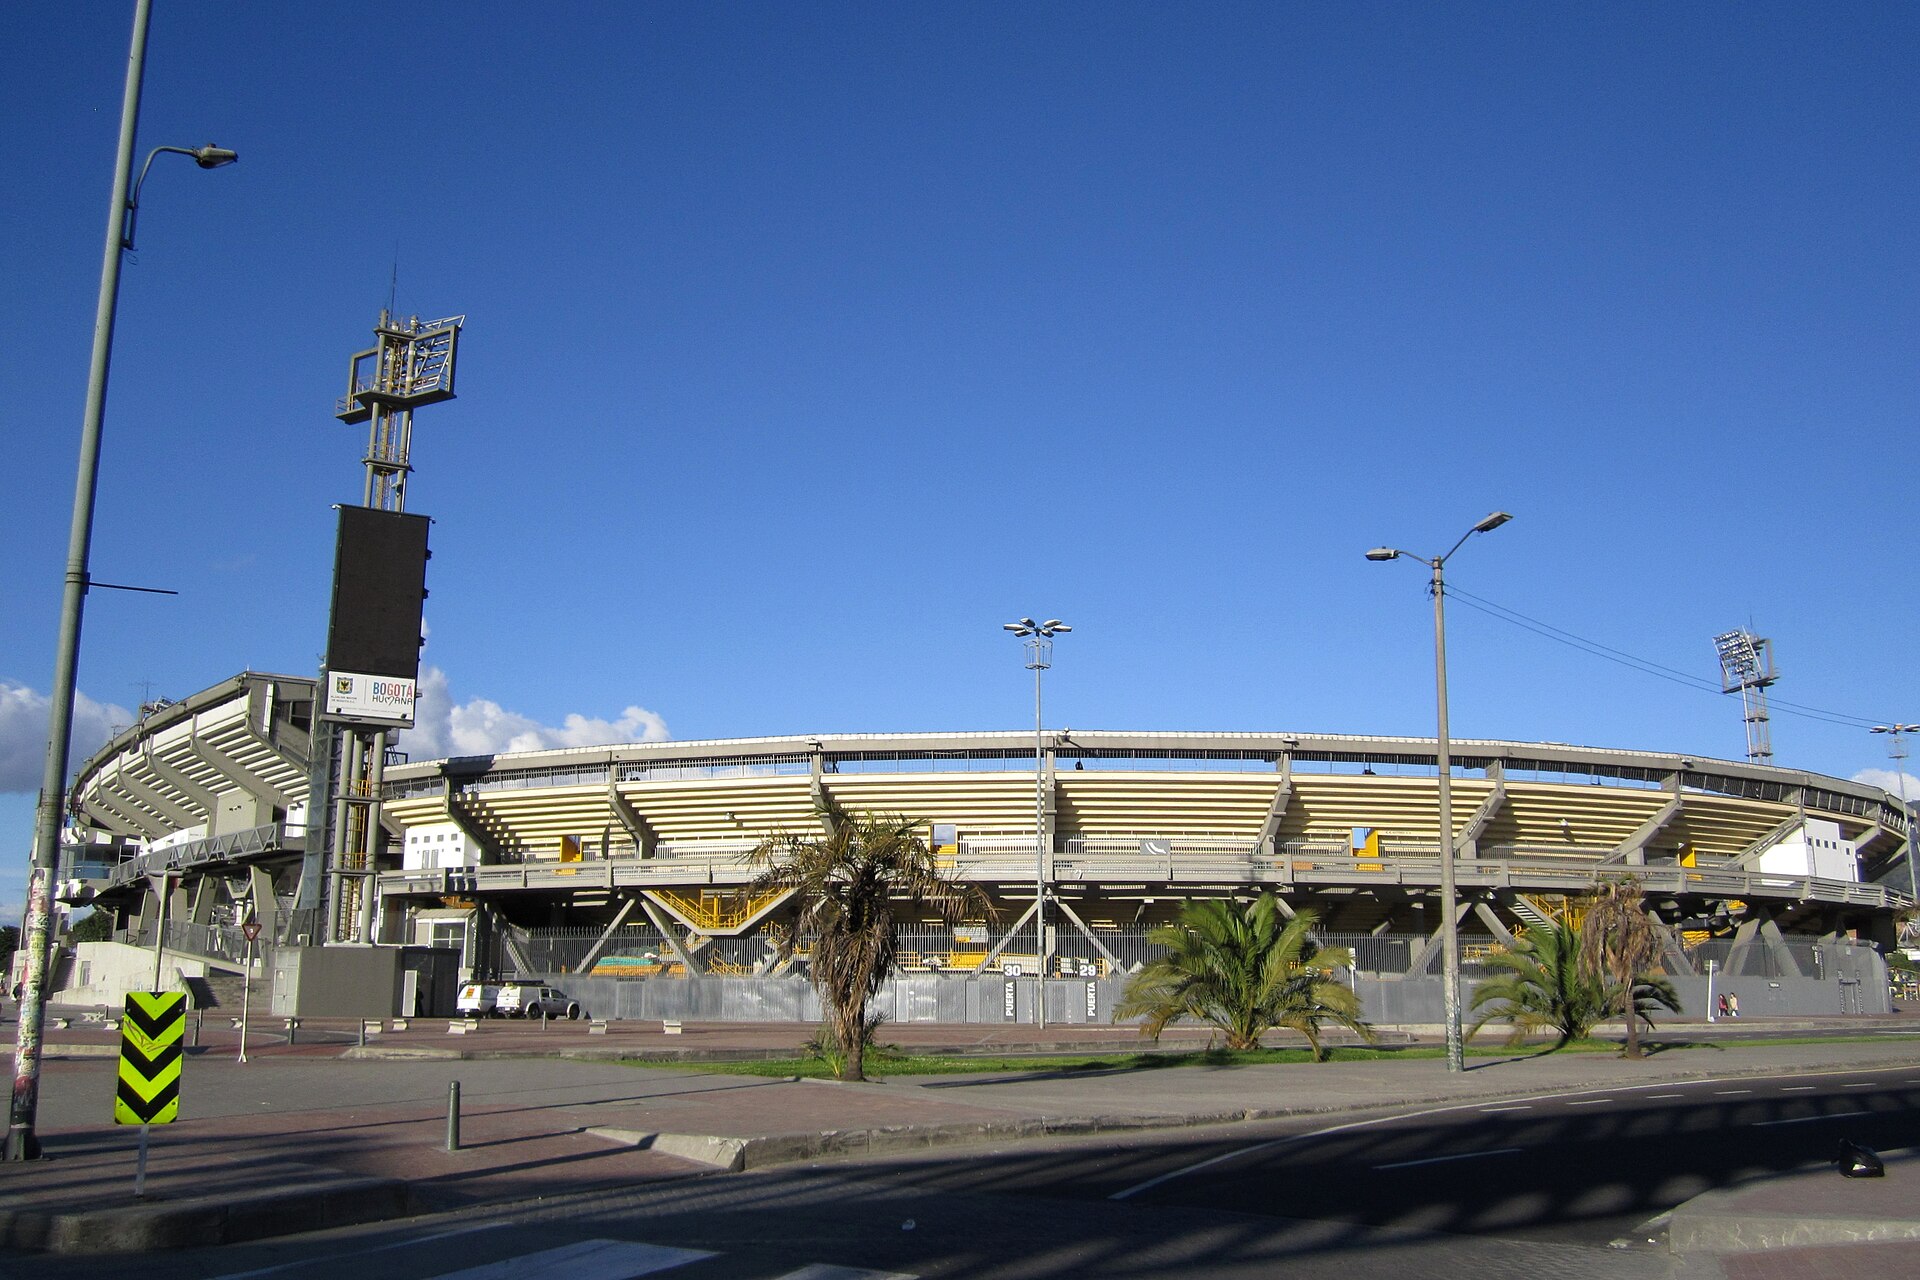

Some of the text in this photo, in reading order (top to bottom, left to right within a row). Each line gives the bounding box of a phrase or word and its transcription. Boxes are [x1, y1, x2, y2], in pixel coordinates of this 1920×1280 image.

[373, 682, 413, 698] BOGOTÁ
[1004, 965, 1021, 976] 30
[1079, 965, 1096, 976] 29
[1006, 982, 1014, 1017] PUERTA
[1088, 982, 1096, 1017] PUERTA
